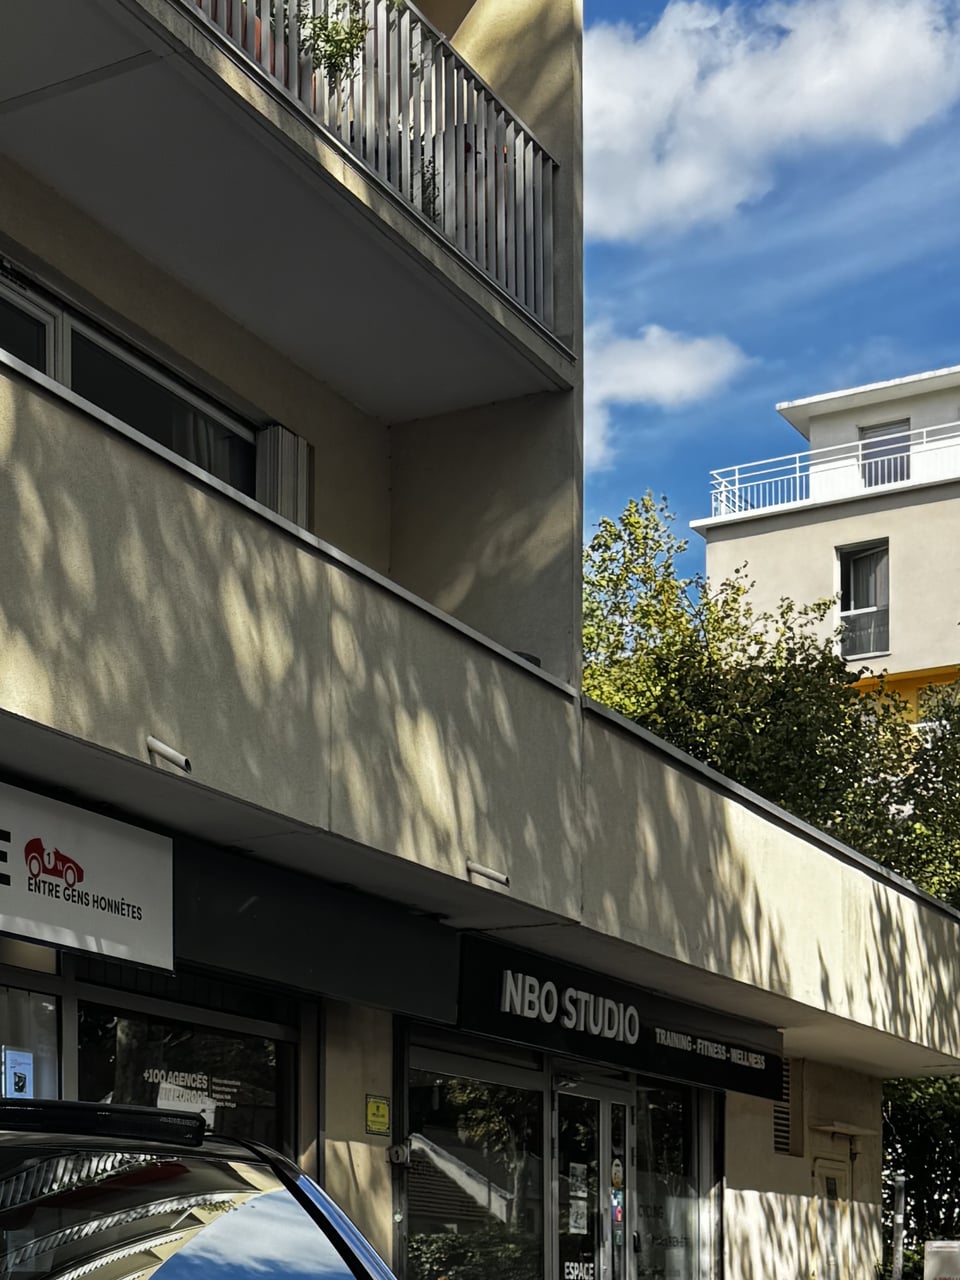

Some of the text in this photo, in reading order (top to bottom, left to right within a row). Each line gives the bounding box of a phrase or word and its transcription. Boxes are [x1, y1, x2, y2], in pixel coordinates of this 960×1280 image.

[28, 877, 142, 920] ENTRE GENS HONNÊTES
[501, 969, 640, 1045] NBO STUDIO
[655, 1028, 693, 1051] TRAINING
[696, 1039, 727, 1060] FITNESS
[730, 1048, 766, 1070] WELLNESS
[143, 1069, 166, 1083] +100
[167, 1071, 208, 1089] AGENCES
[564, 1261, 594, 1280] ESPACE
